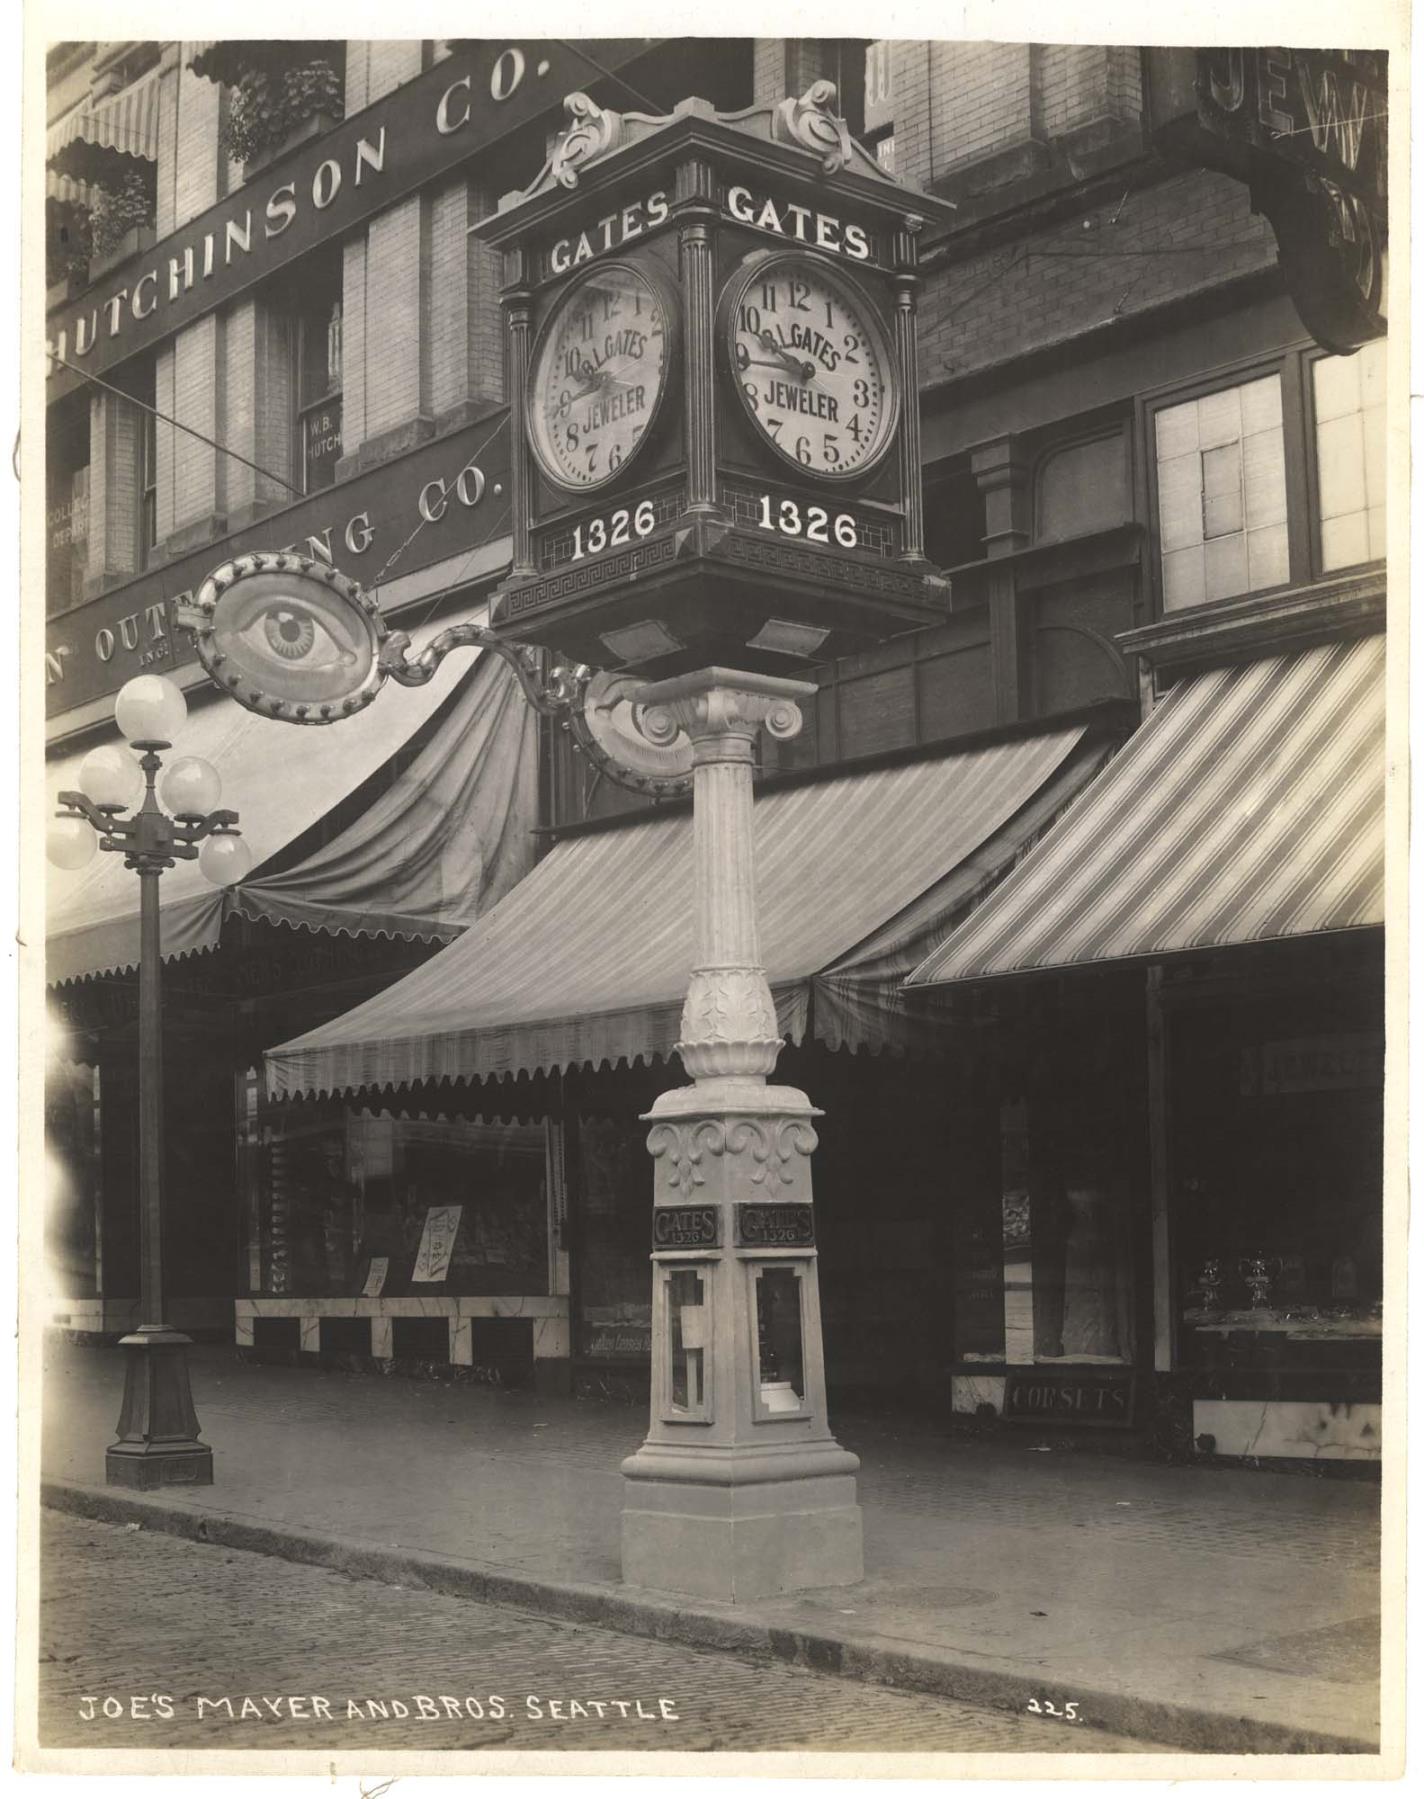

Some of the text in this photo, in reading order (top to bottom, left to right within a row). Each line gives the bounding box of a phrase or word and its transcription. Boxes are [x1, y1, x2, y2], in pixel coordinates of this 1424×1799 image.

[436, 48, 550, 135] CO.
[551, 191, 668, 273] GATES
[728, 186, 869, 259] GATES
[634, 288, 642, 316] 1
[762, 284, 776, 313] 11
[788, 281, 811, 311] 12
[581, 312, 595, 342] 11
[739, 304, 760, 336] 10
[825, 302, 834, 329] 1
[605, 329, 648, 359] GATES
[791, 324, 841, 371] GATES
[844, 335, 859, 364] 2
[564, 347, 581, 380] 10
[764, 381, 839, 423] JEWELER
[853, 379, 870, 408] 3
[583, 385, 645, 434] JEWELER
[566, 422, 579, 453] 8
[767, 418, 783, 446] 7
[846, 413, 863, 442] 4
[585, 443, 599, 472] 7
[795, 437, 811, 465] 6
[823, 434, 840, 463] 5
[419, 466, 503, 522] CO.
[572, 501, 655, 561] 1326
[759, 495, 857, 548] 1326
[655, 1210, 715, 1242] GATES
[672, 1232, 701, 1244] 1326
[742, 1208, 811, 1239] GATES
[762, 1228, 796, 1241] 1326
[1011, 1386, 1125, 1409] CORSETS
